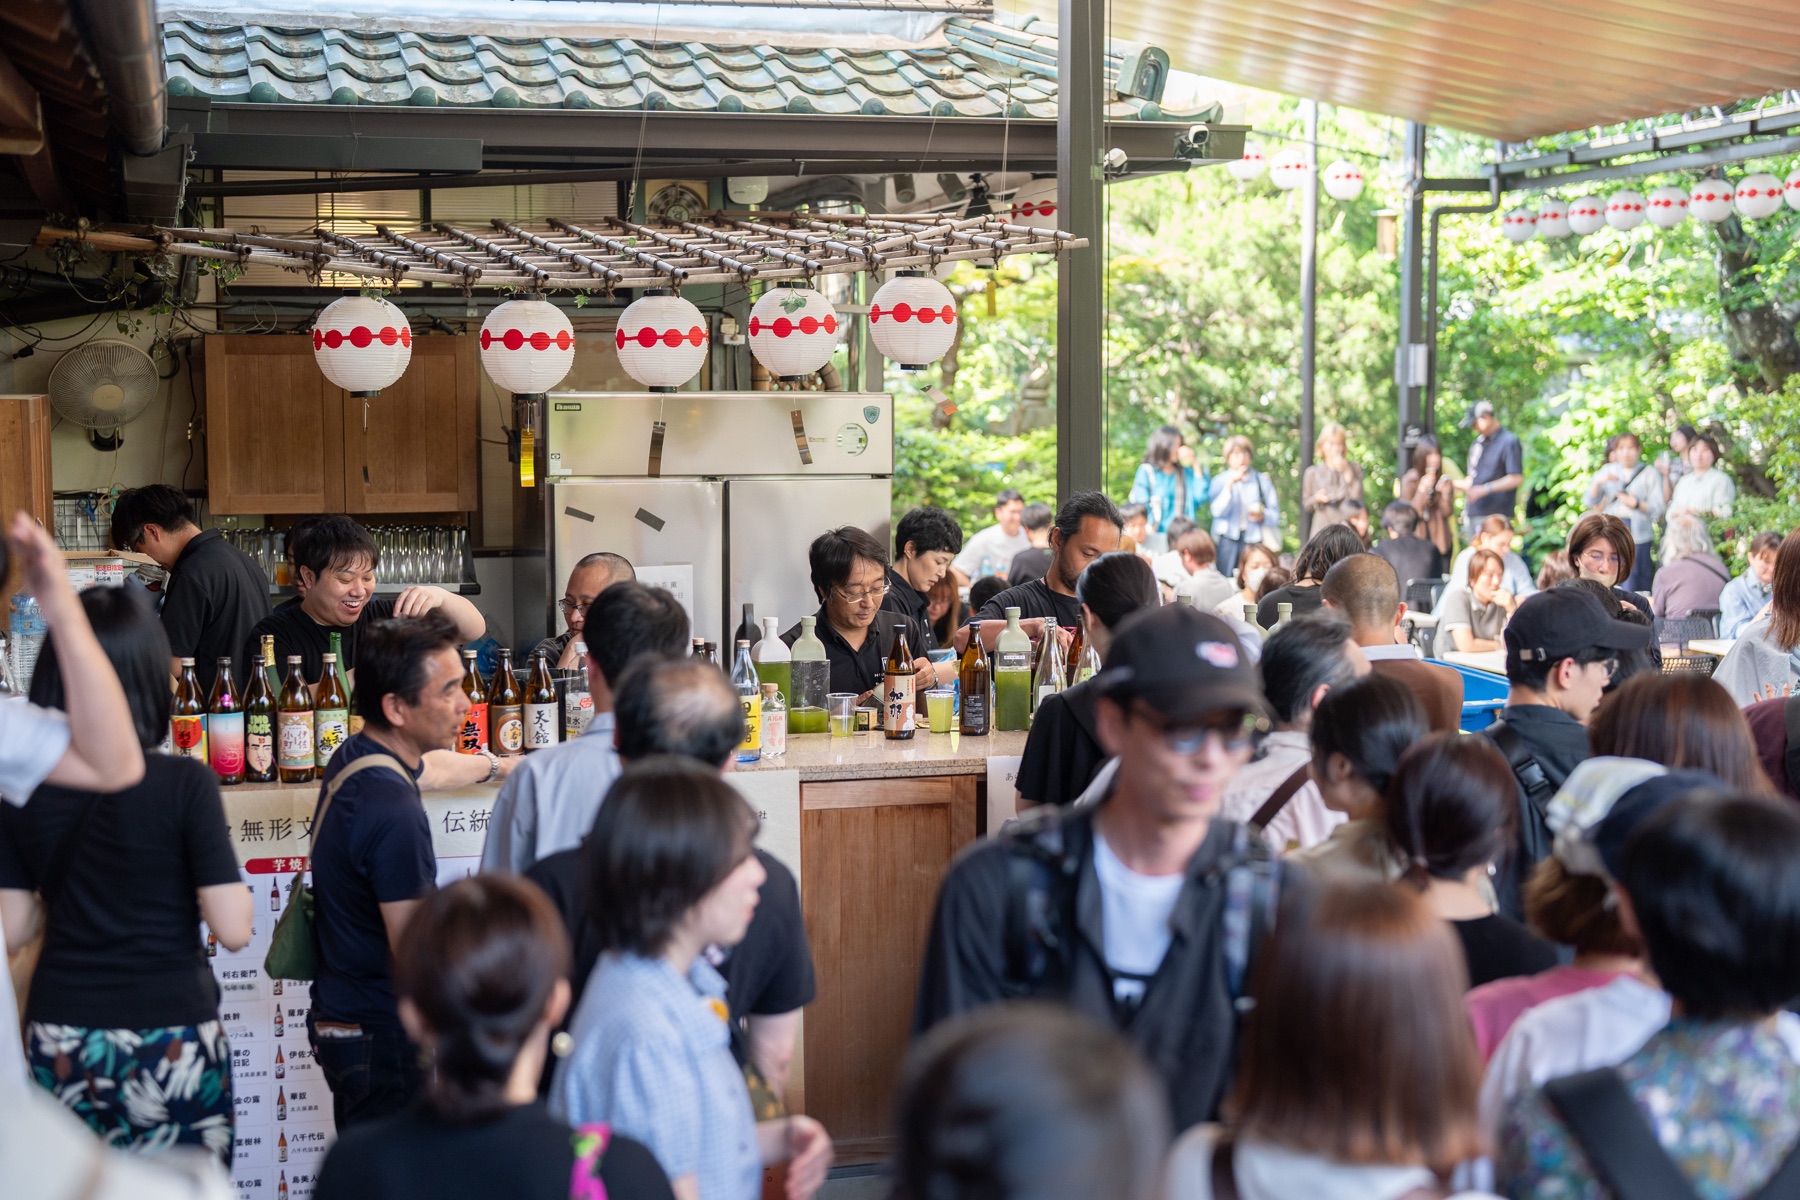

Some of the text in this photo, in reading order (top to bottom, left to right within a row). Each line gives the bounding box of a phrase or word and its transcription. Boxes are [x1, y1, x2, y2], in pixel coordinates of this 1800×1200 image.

[250, 715, 269, 724] IMO
[248, 724, 271, 734] ROCK
[222, 970, 257, 979] 利右衛門
[291, 1132, 325, 1142] 八千代伝
